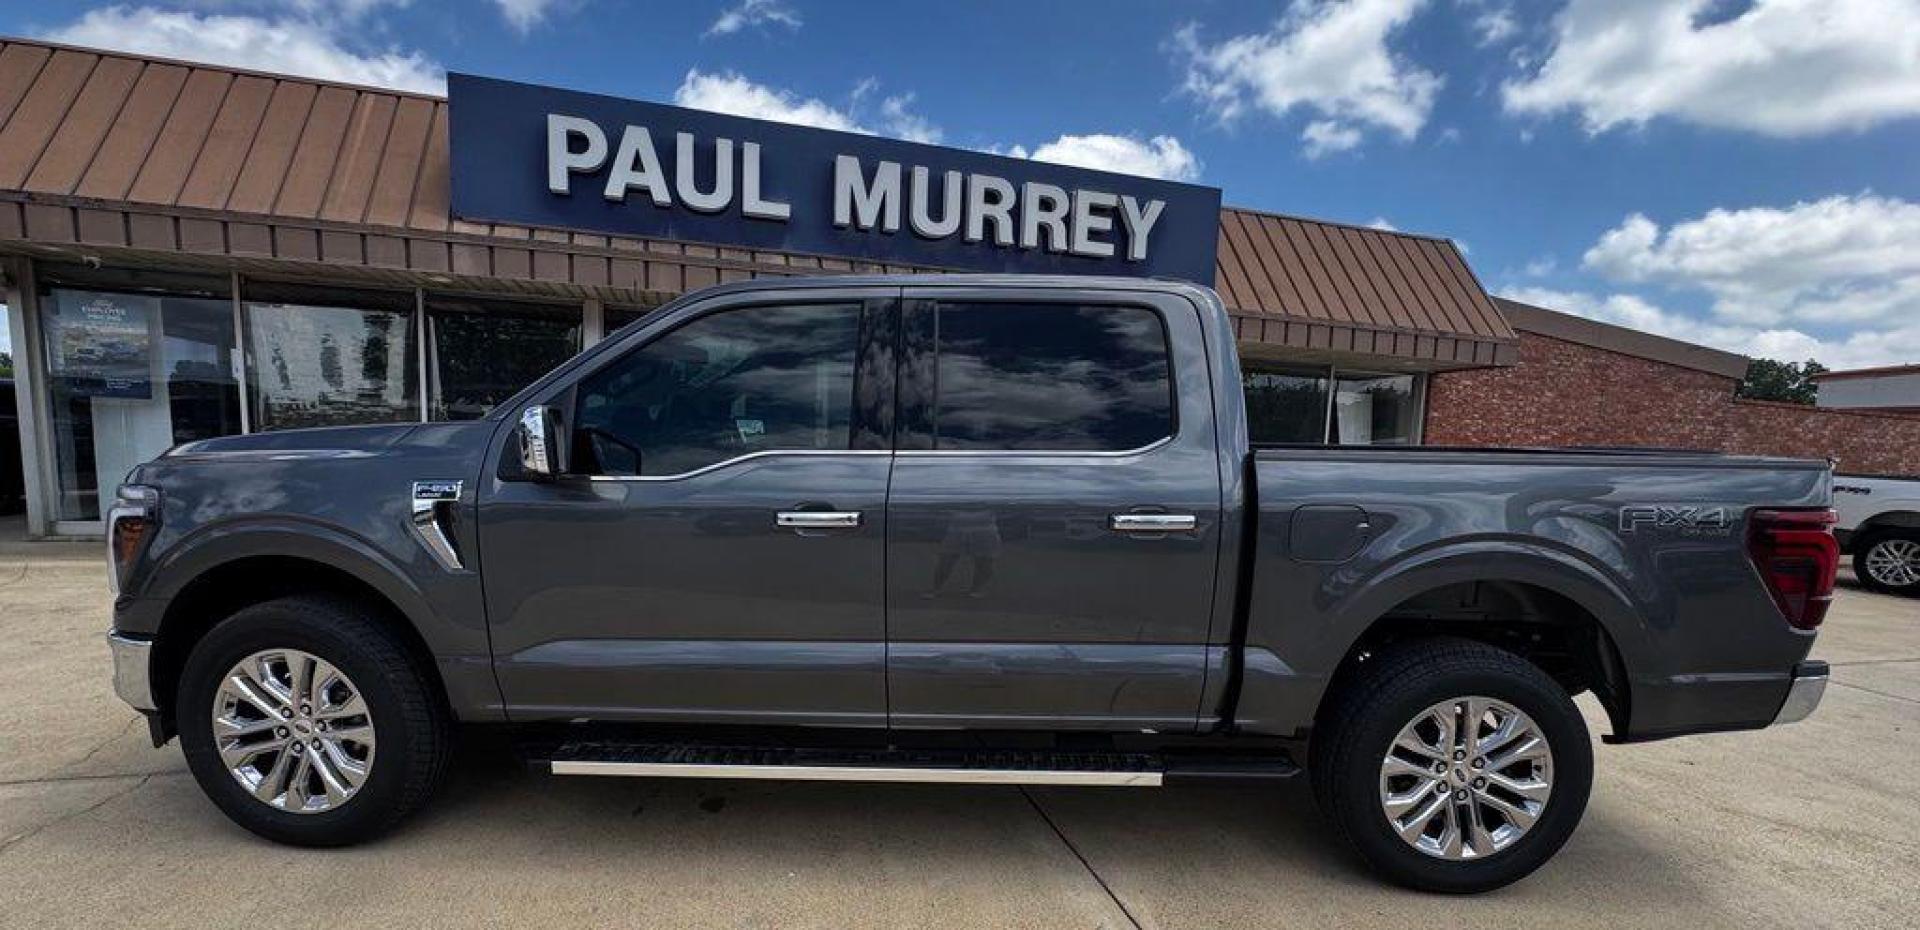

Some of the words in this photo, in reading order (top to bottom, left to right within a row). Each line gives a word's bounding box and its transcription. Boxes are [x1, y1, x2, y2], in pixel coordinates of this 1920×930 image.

[547, 113, 791, 219] PAUL
[833, 154, 1165, 260] MURREY
[1619, 505, 1731, 533] FX4
